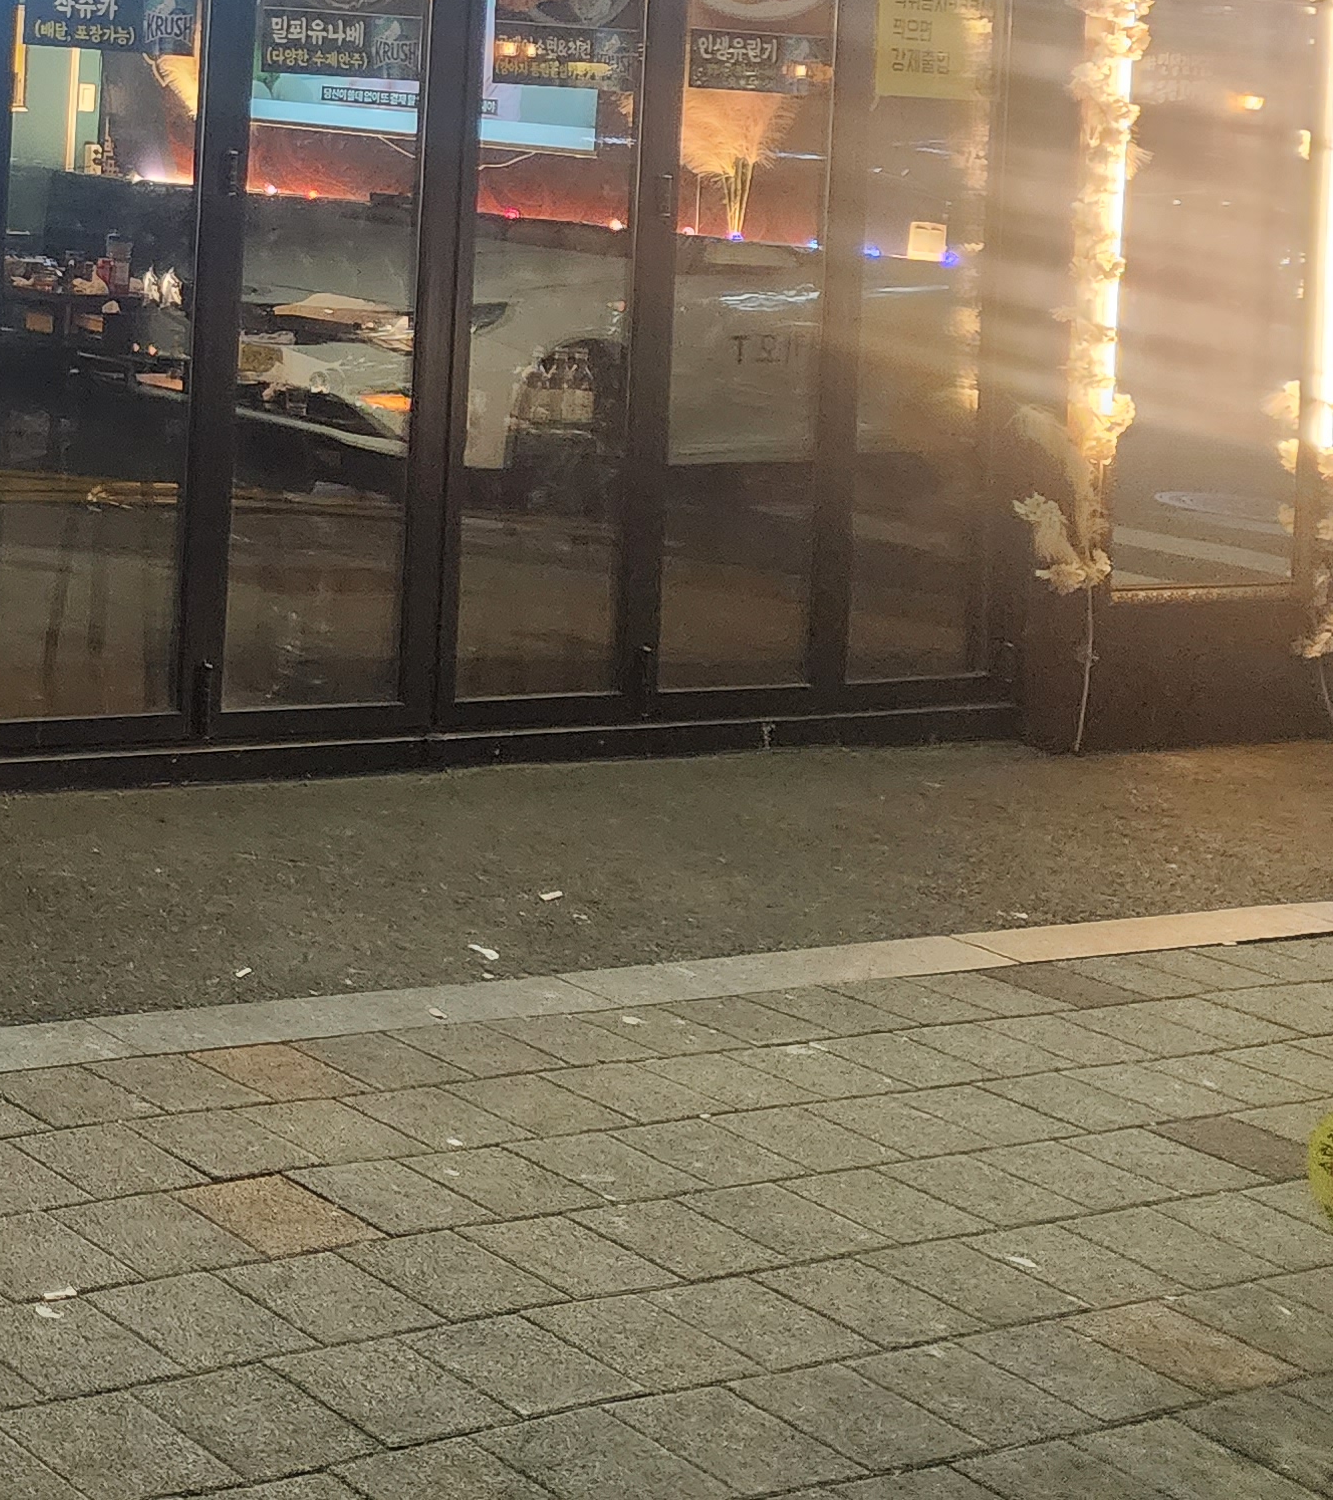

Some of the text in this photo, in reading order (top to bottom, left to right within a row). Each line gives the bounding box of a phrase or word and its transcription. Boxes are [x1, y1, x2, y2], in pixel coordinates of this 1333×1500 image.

[35, 19, 135, 45] (배달, 포장가능)
[146, 14, 193, 46] KRUSH
[266, 47, 368, 69] (다양한 수제안주)
[374, 41, 418, 69] KRUSH
[699, 34, 777, 62] 인생유린기
